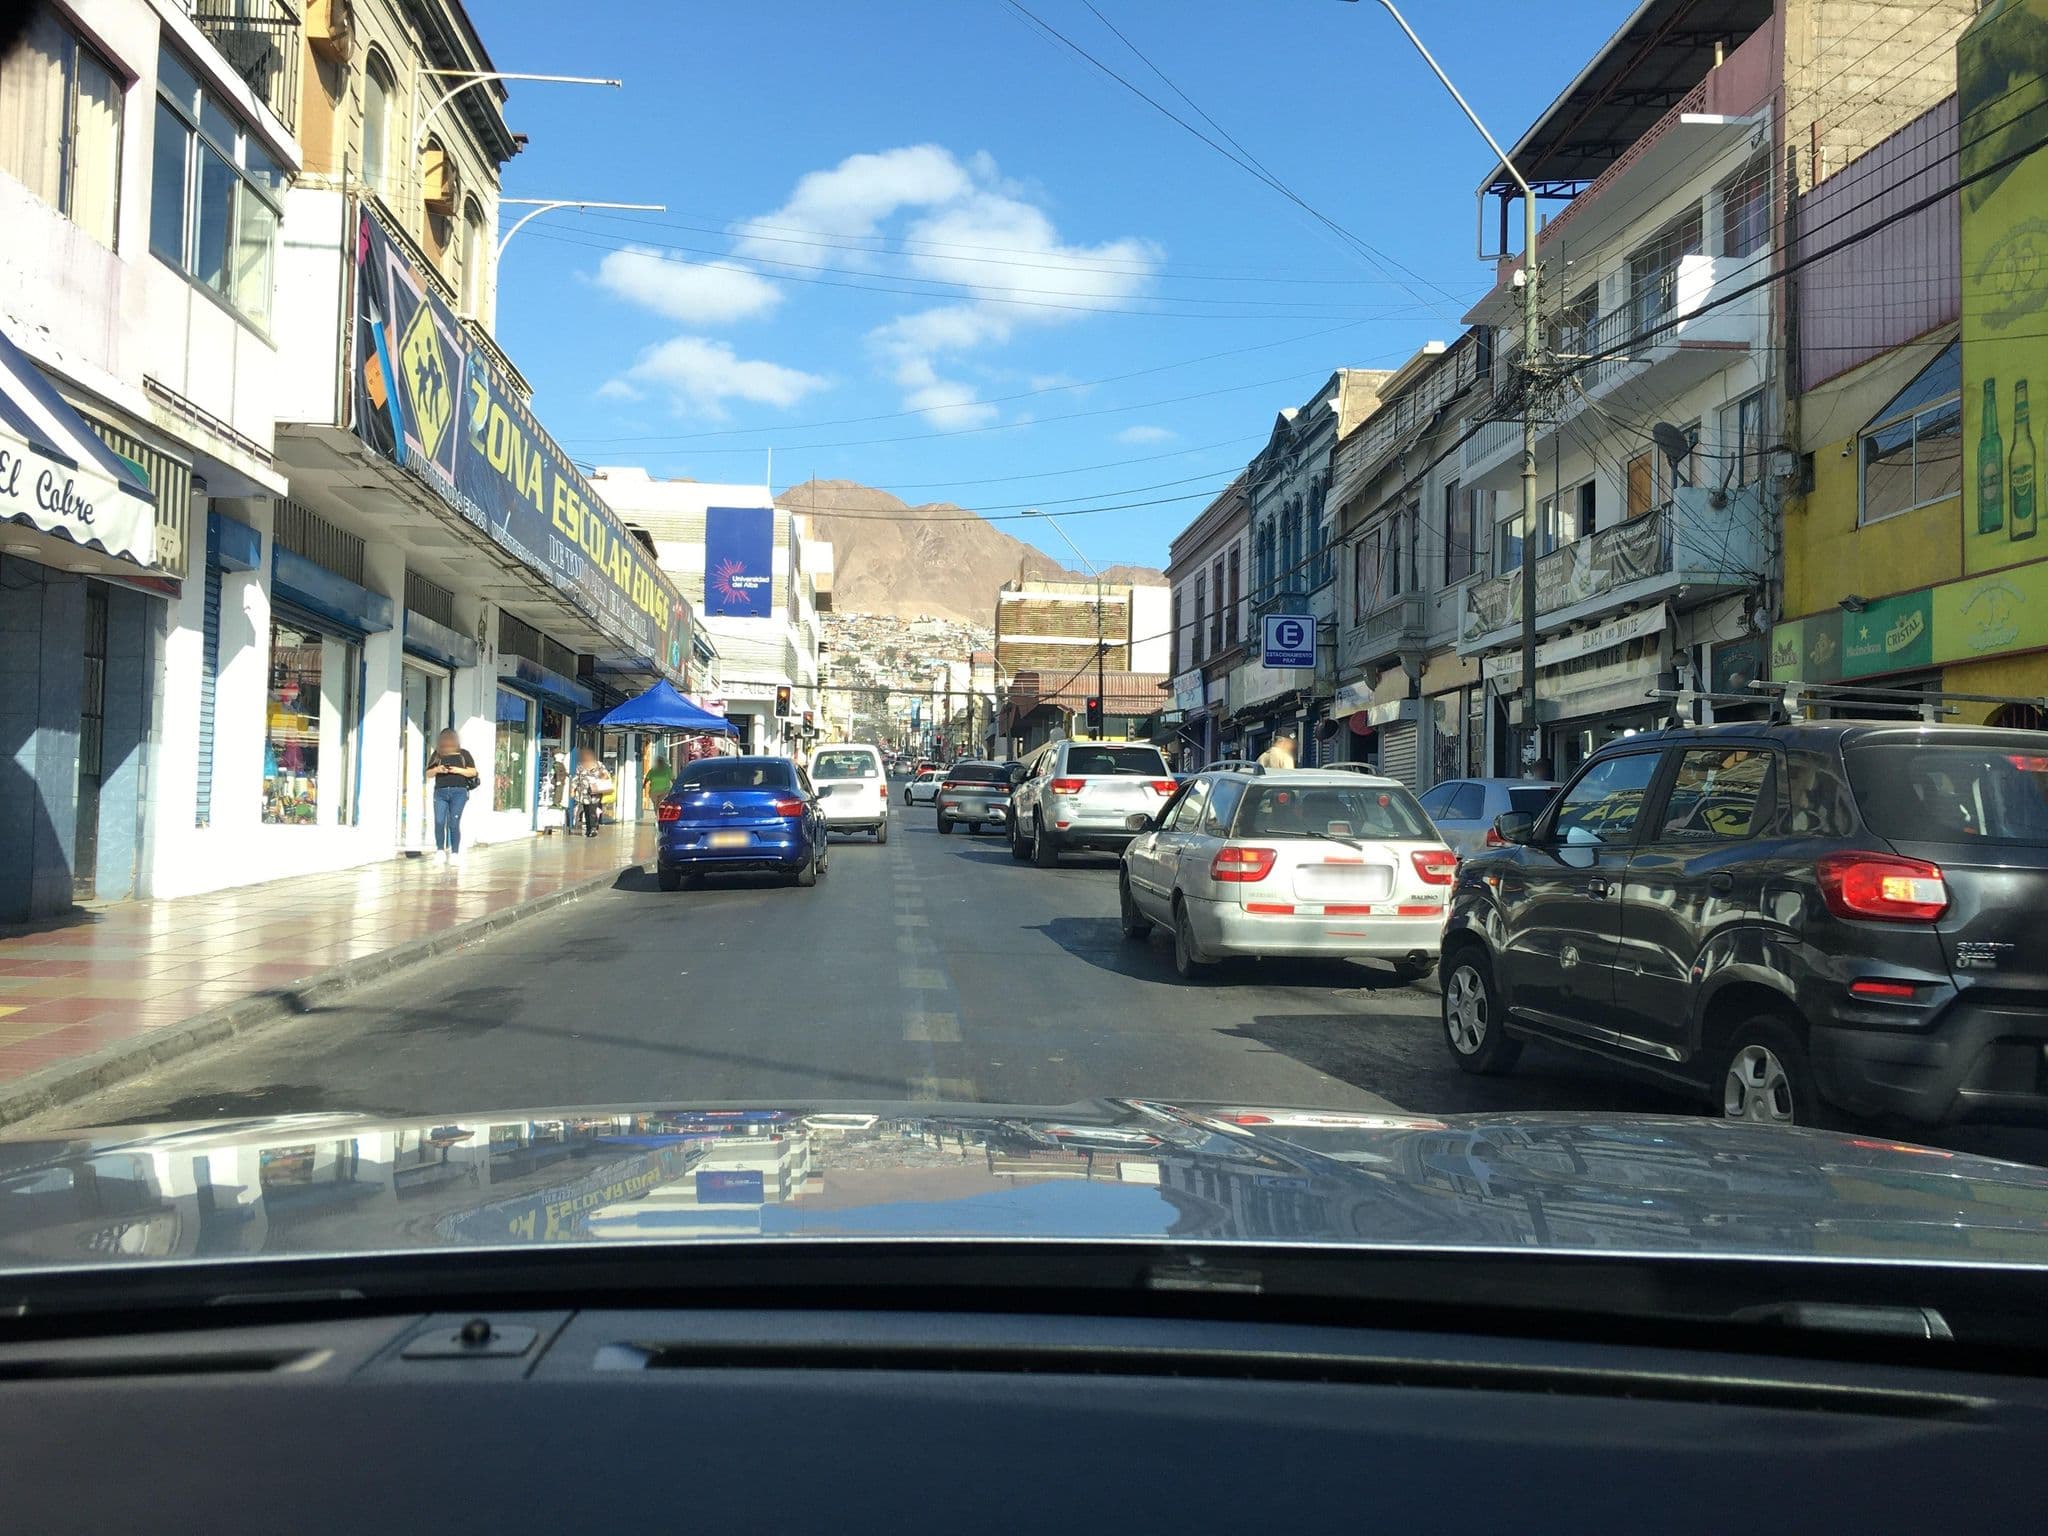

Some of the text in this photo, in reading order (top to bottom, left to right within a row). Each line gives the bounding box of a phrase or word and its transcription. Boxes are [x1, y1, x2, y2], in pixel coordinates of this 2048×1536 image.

[0, 450, 96, 525] El Cobre
[468, 377, 544, 514] ZONA
[552, 473, 632, 596] ESCOLAR
[732, 575, 769, 583] Universidad
[1284, 625, 1298, 644] E
[1582, 630, 1603, 650] BLACK
[1617, 617, 1639, 638] WHITE
[1886, 619, 1920, 647] CRISTAL
